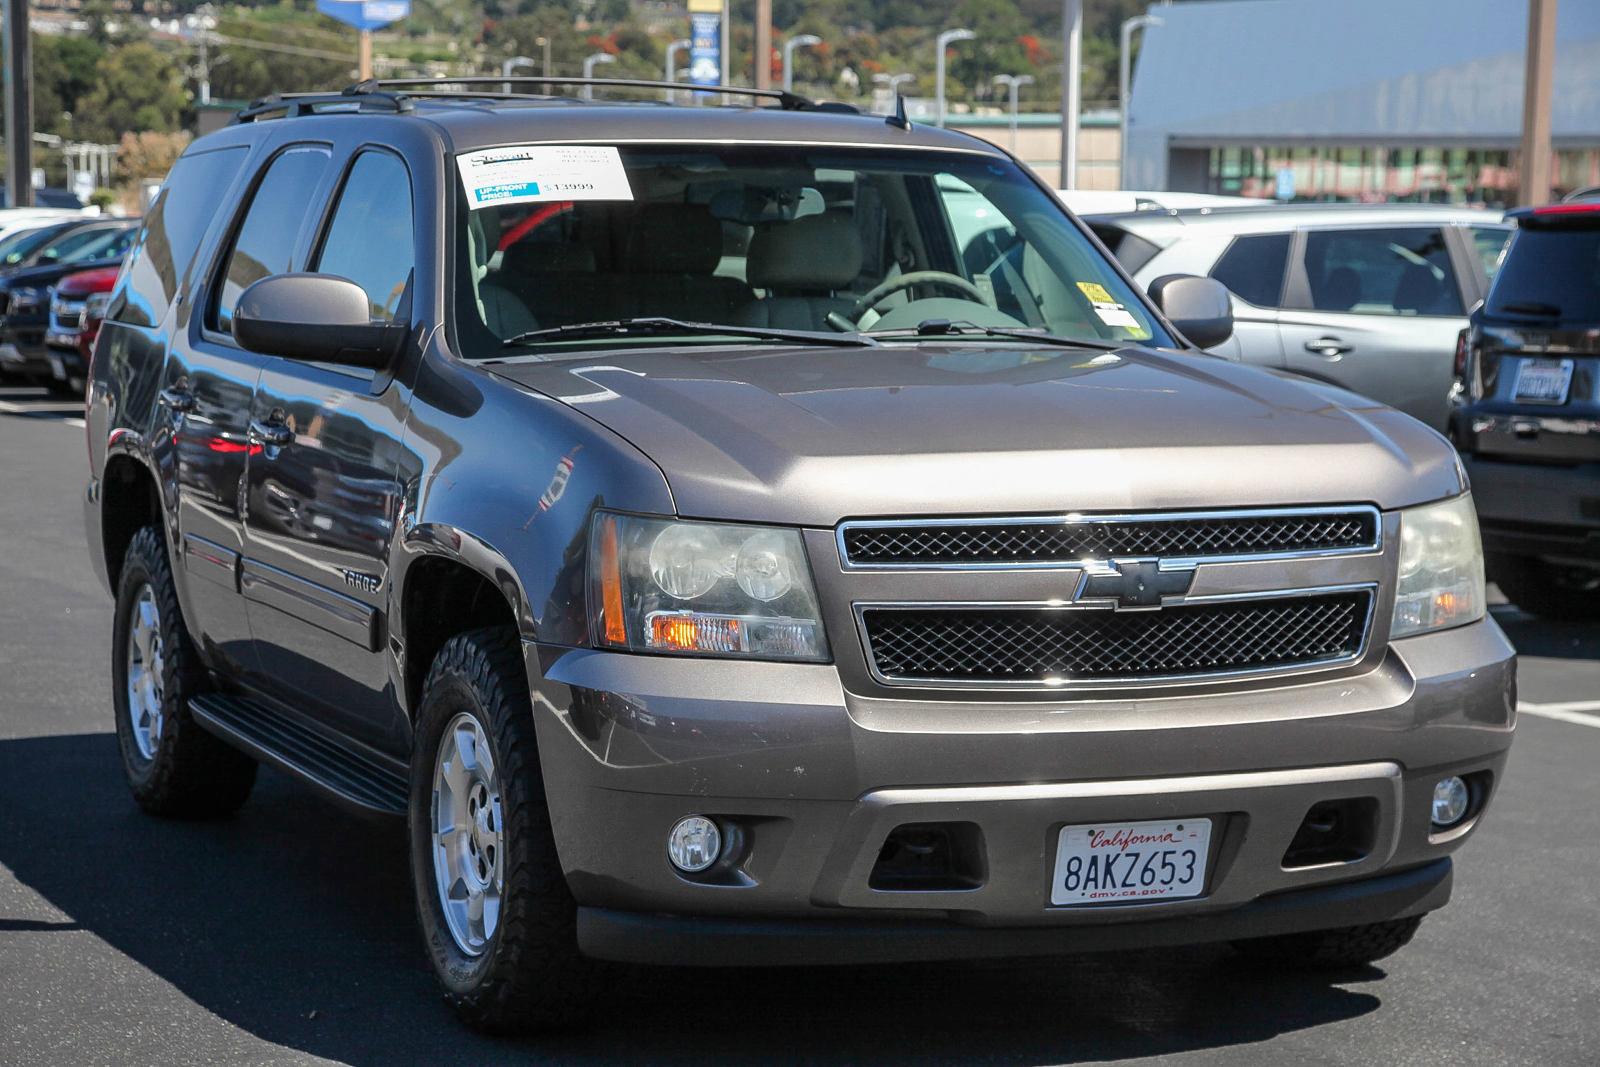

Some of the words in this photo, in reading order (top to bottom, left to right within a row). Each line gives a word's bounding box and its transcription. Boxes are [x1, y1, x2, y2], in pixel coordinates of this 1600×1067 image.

[480, 183, 528, 195] UP-FRONT
[343, 569, 377, 594] TAHOE
[1090, 828, 1182, 852] California
[1064, 849, 1197, 891] 8AKZ653
[1090, 887, 1166, 899] dmv.ca.gov
